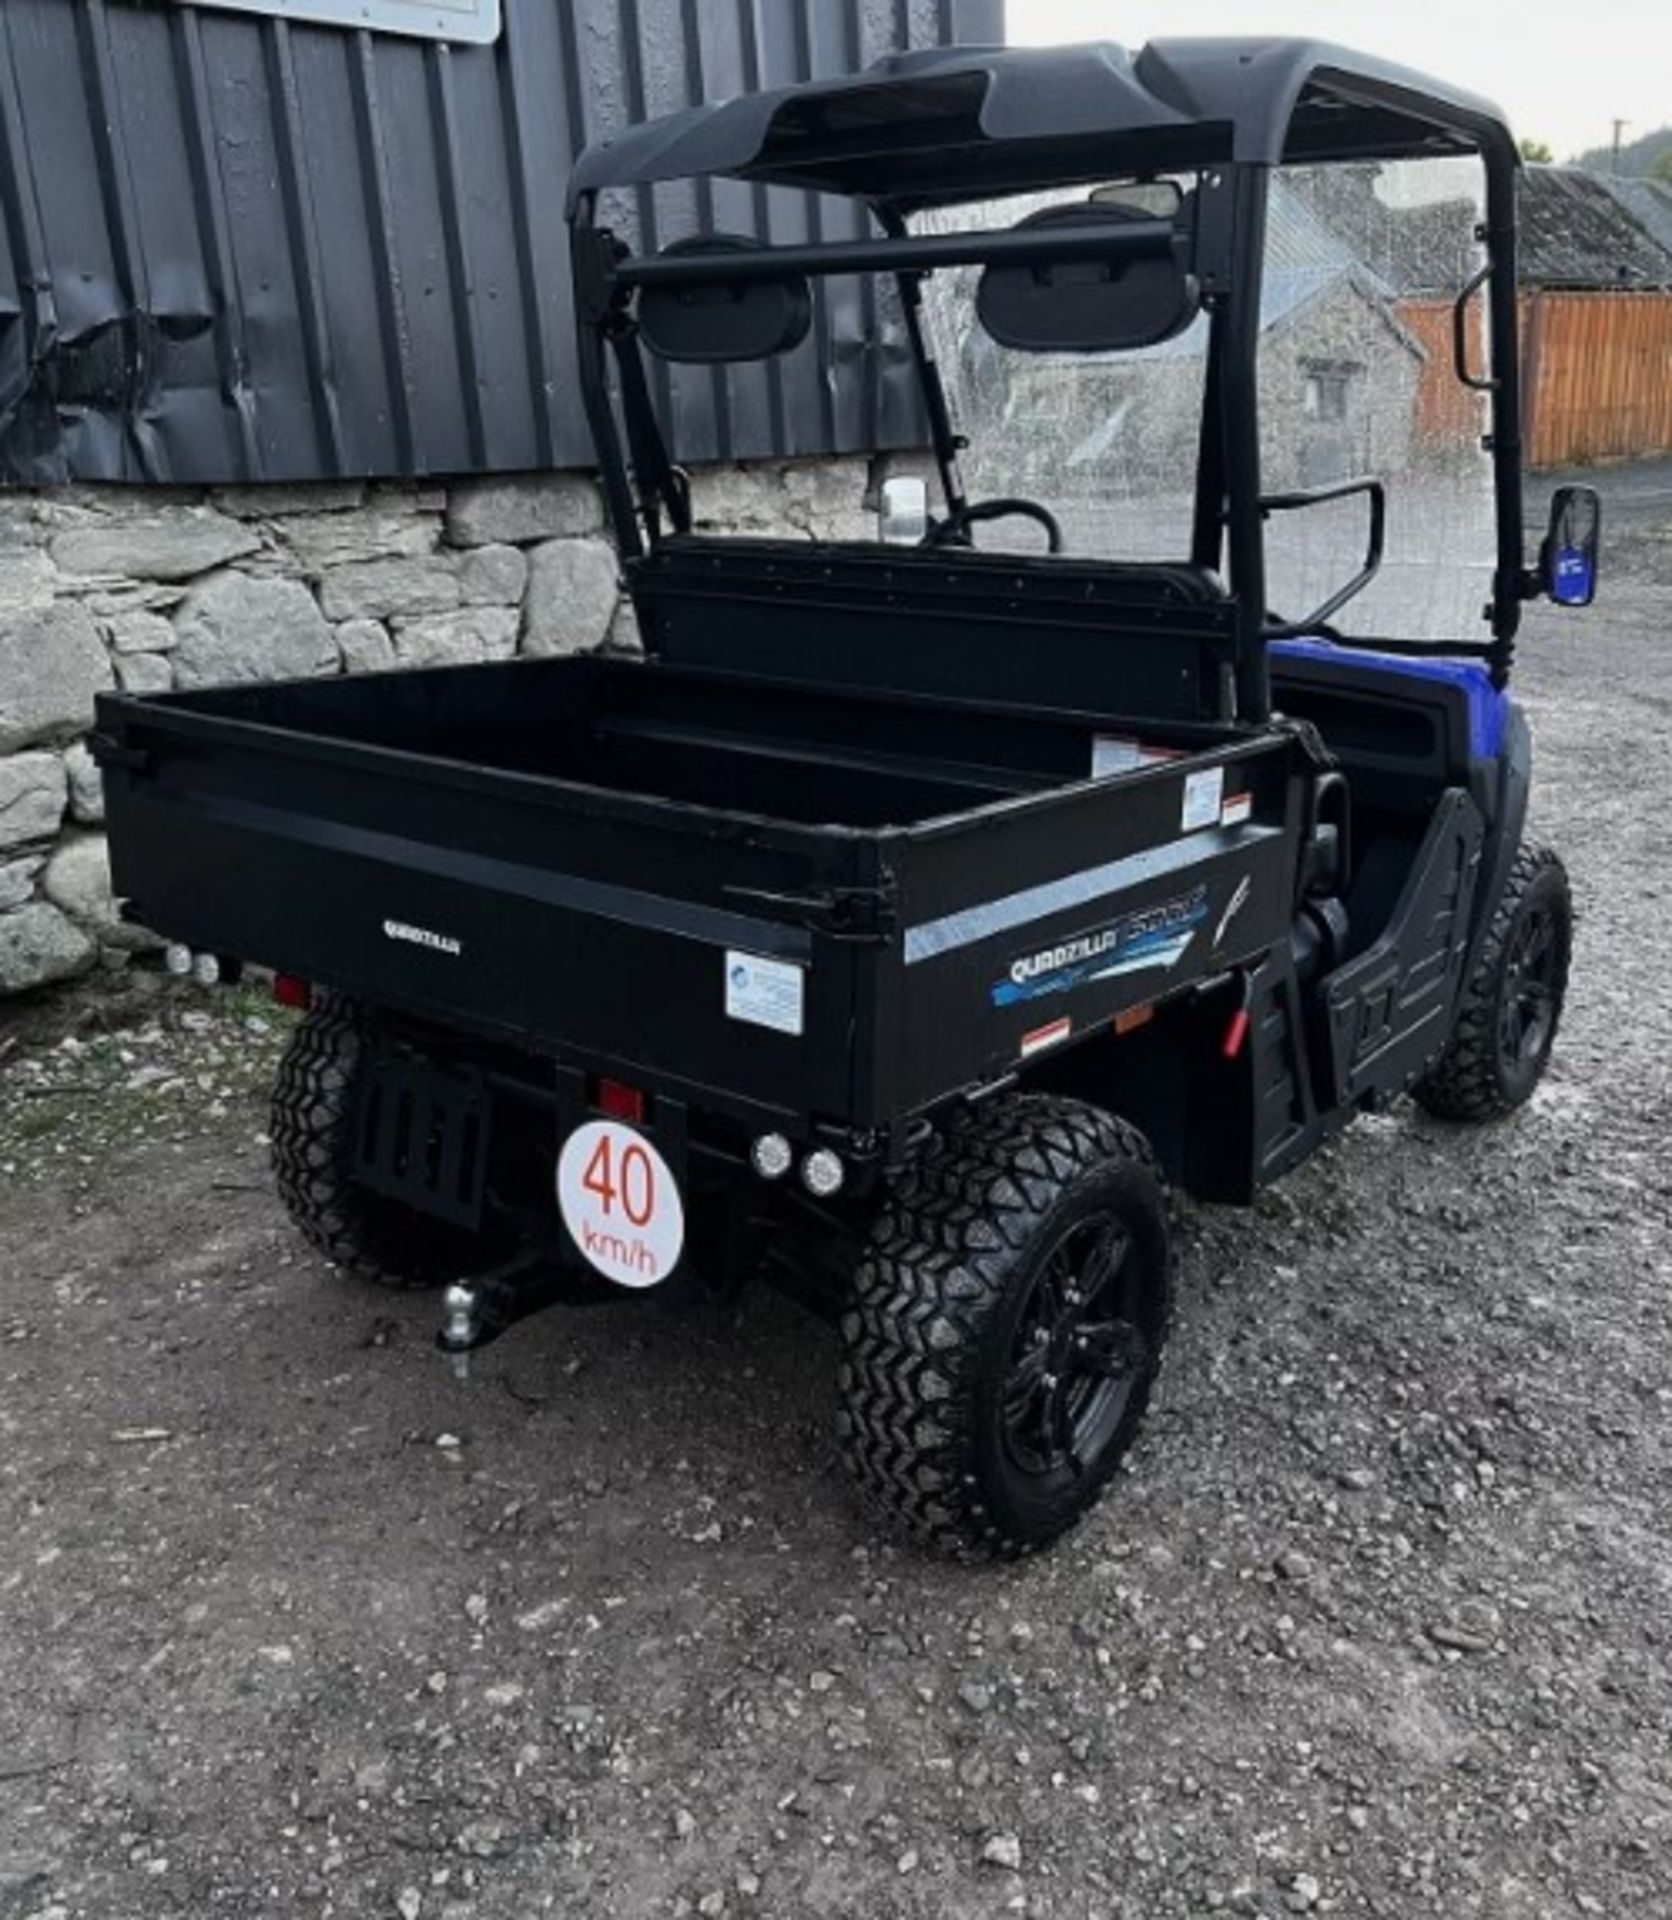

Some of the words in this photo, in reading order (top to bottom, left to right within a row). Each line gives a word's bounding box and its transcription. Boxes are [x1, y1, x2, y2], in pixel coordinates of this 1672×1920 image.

[1010, 931, 1118, 985] QUADZILLA
[582, 1134, 655, 1227] 40
[582, 1219, 657, 1275] km/h
